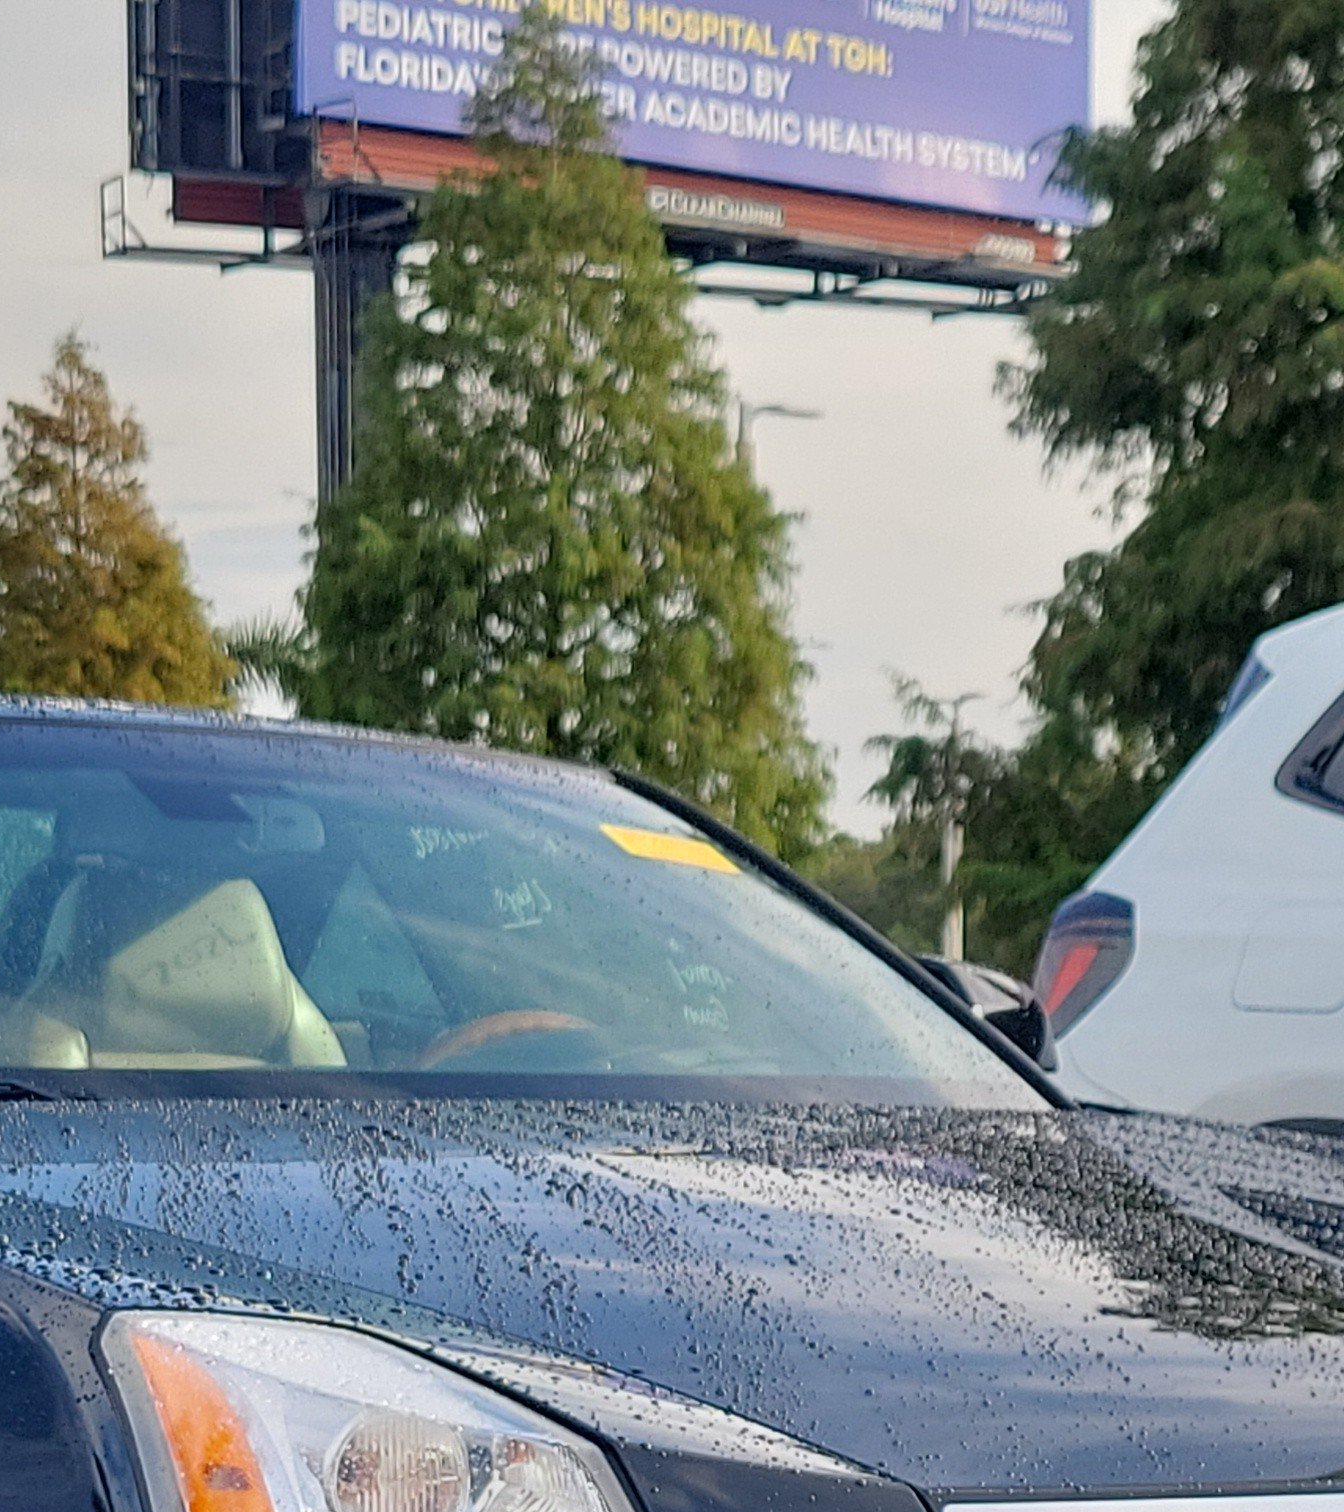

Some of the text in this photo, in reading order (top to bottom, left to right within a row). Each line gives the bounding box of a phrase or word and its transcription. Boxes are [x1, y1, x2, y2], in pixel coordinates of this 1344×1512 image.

[336, 0, 505, 56] PEDIATRIC
[600, 37, 748, 95] POWERED
[754, 62, 793, 103] BY
[635, 5, 778, 59] HOSPITAL
[784, 28, 822, 66] AT
[643, 90, 802, 148] ACADEMIC
[806, 114, 914, 165] HEALTH
